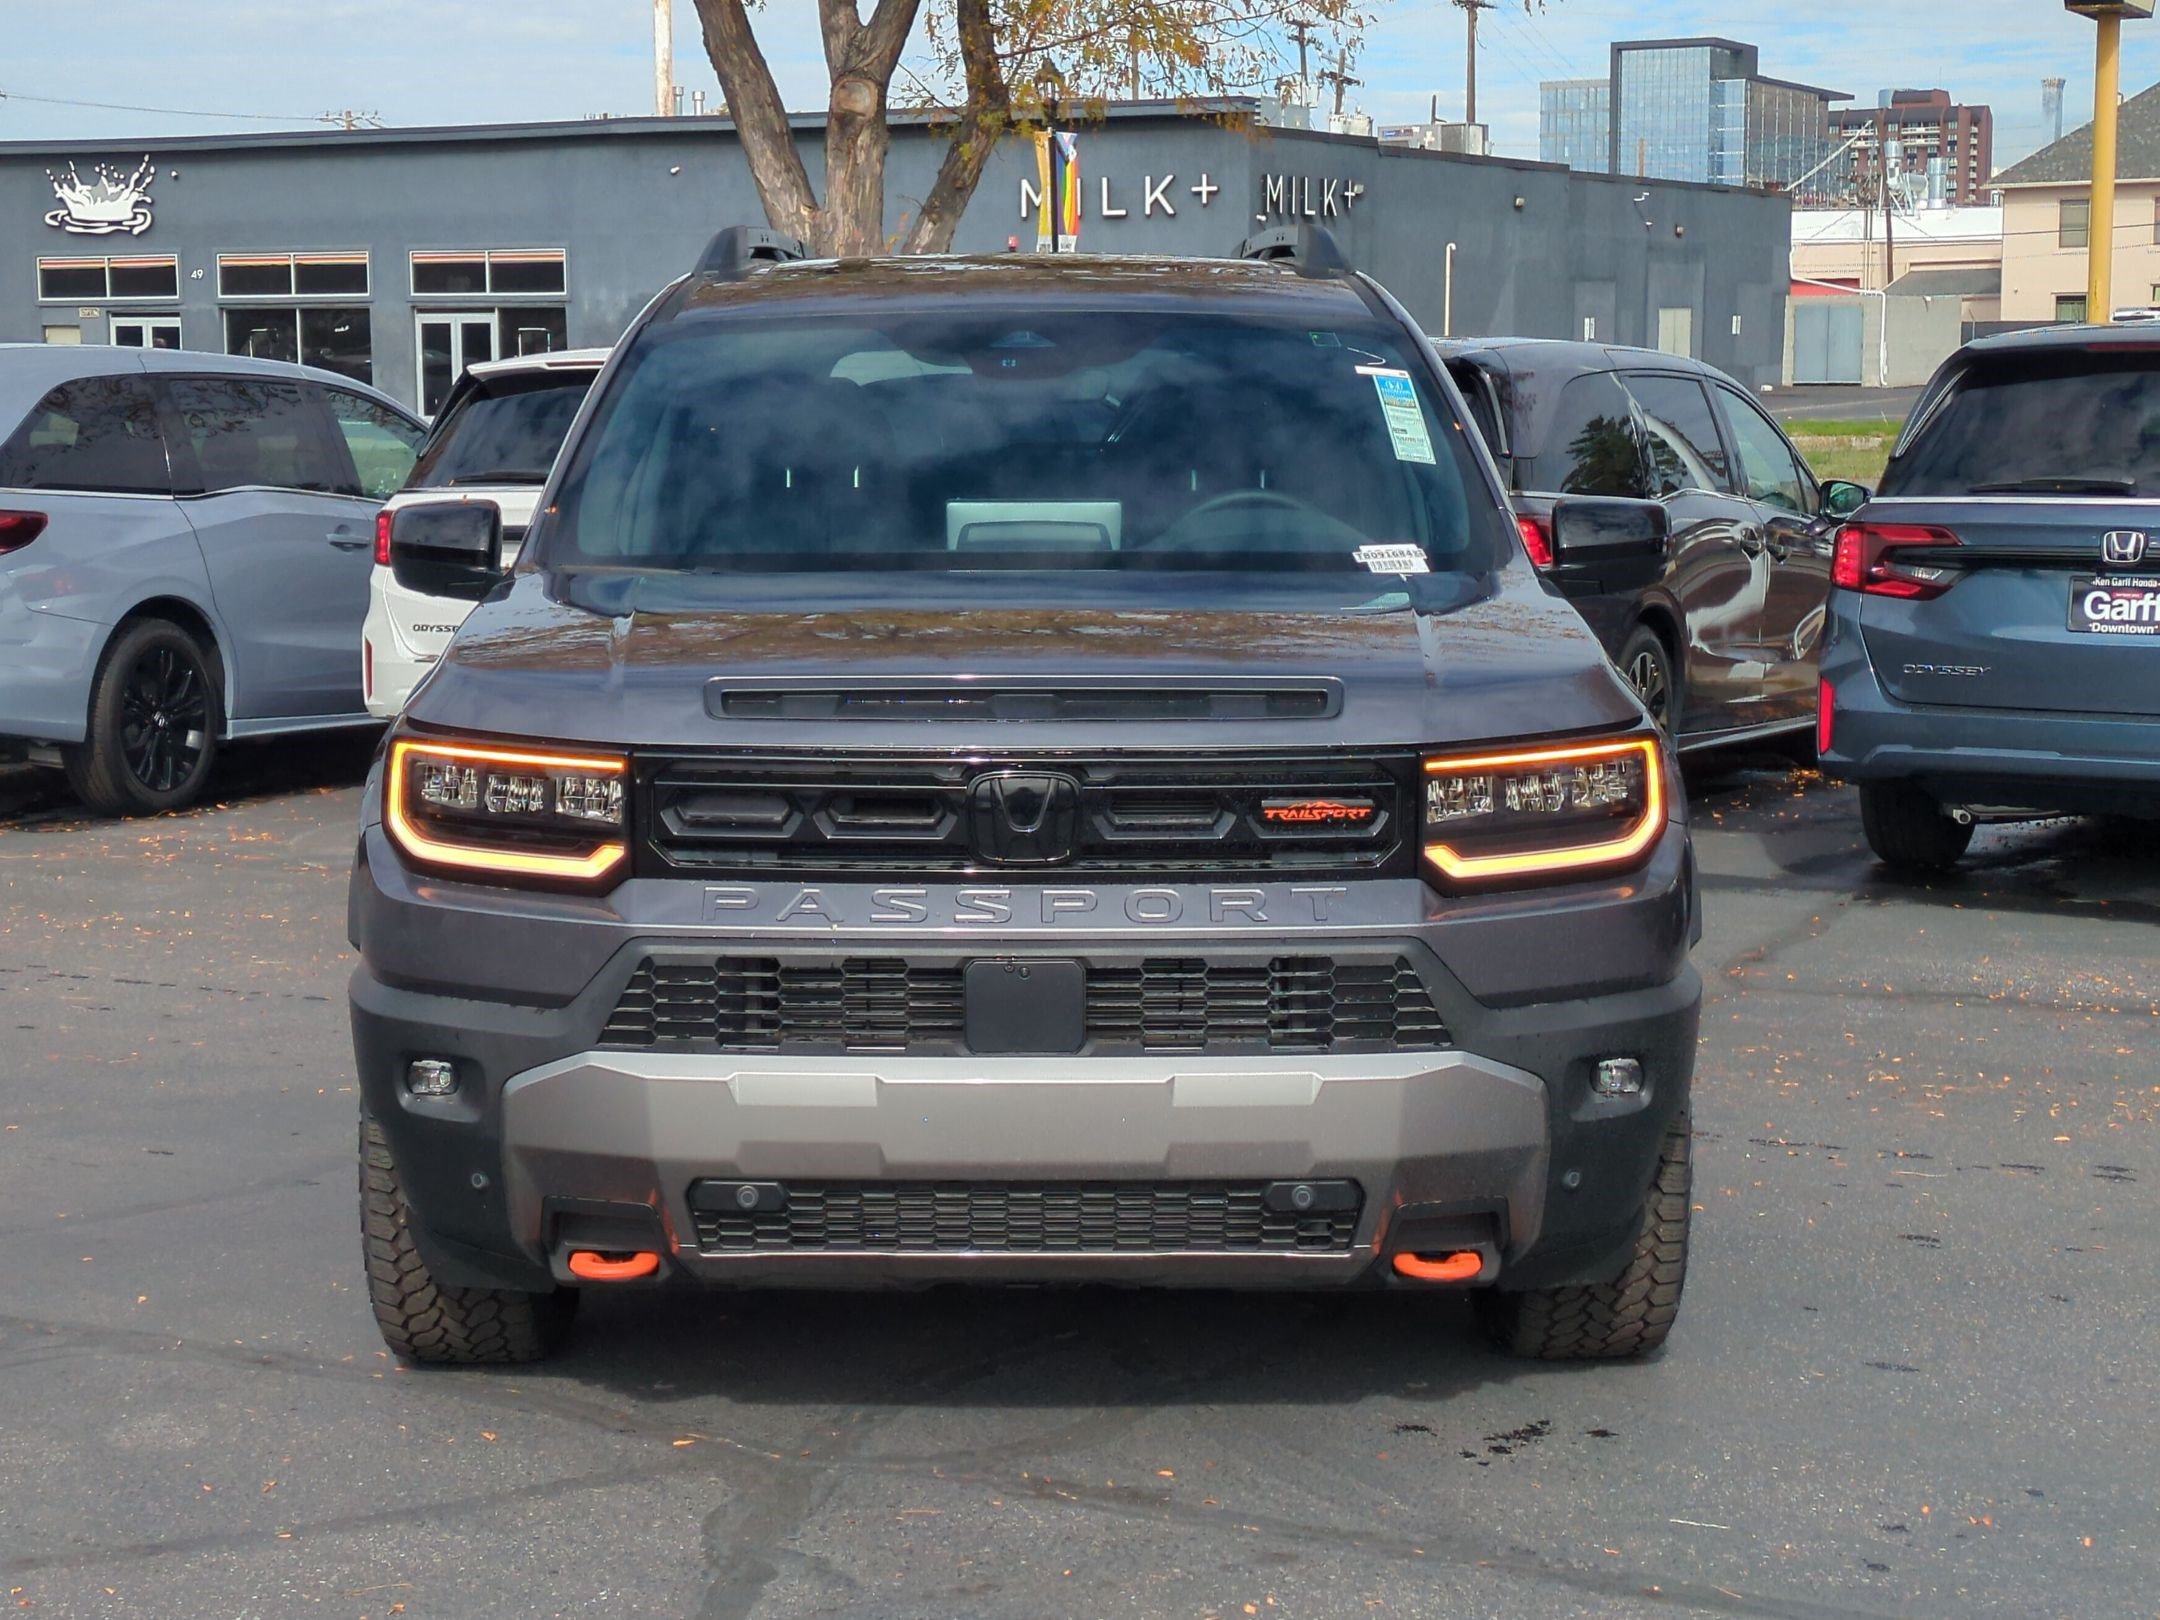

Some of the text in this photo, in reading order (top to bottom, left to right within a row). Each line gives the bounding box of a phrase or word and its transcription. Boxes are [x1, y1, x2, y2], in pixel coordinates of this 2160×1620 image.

[1020, 174, 1218, 218] MILK+
[1265, 173, 1356, 217] MILK+
[190, 269, 204, 280] 49
[2095, 577, 2110, 586] Ken
[2132, 578, 2158, 588] Honda
[2091, 622, 2155, 634] Downtown
[1903, 664, 1992, 677] ODYSSEY
[1263, 808, 1372, 821] TRAILSPORT
[702, 886, 1348, 924] PASSPORT
